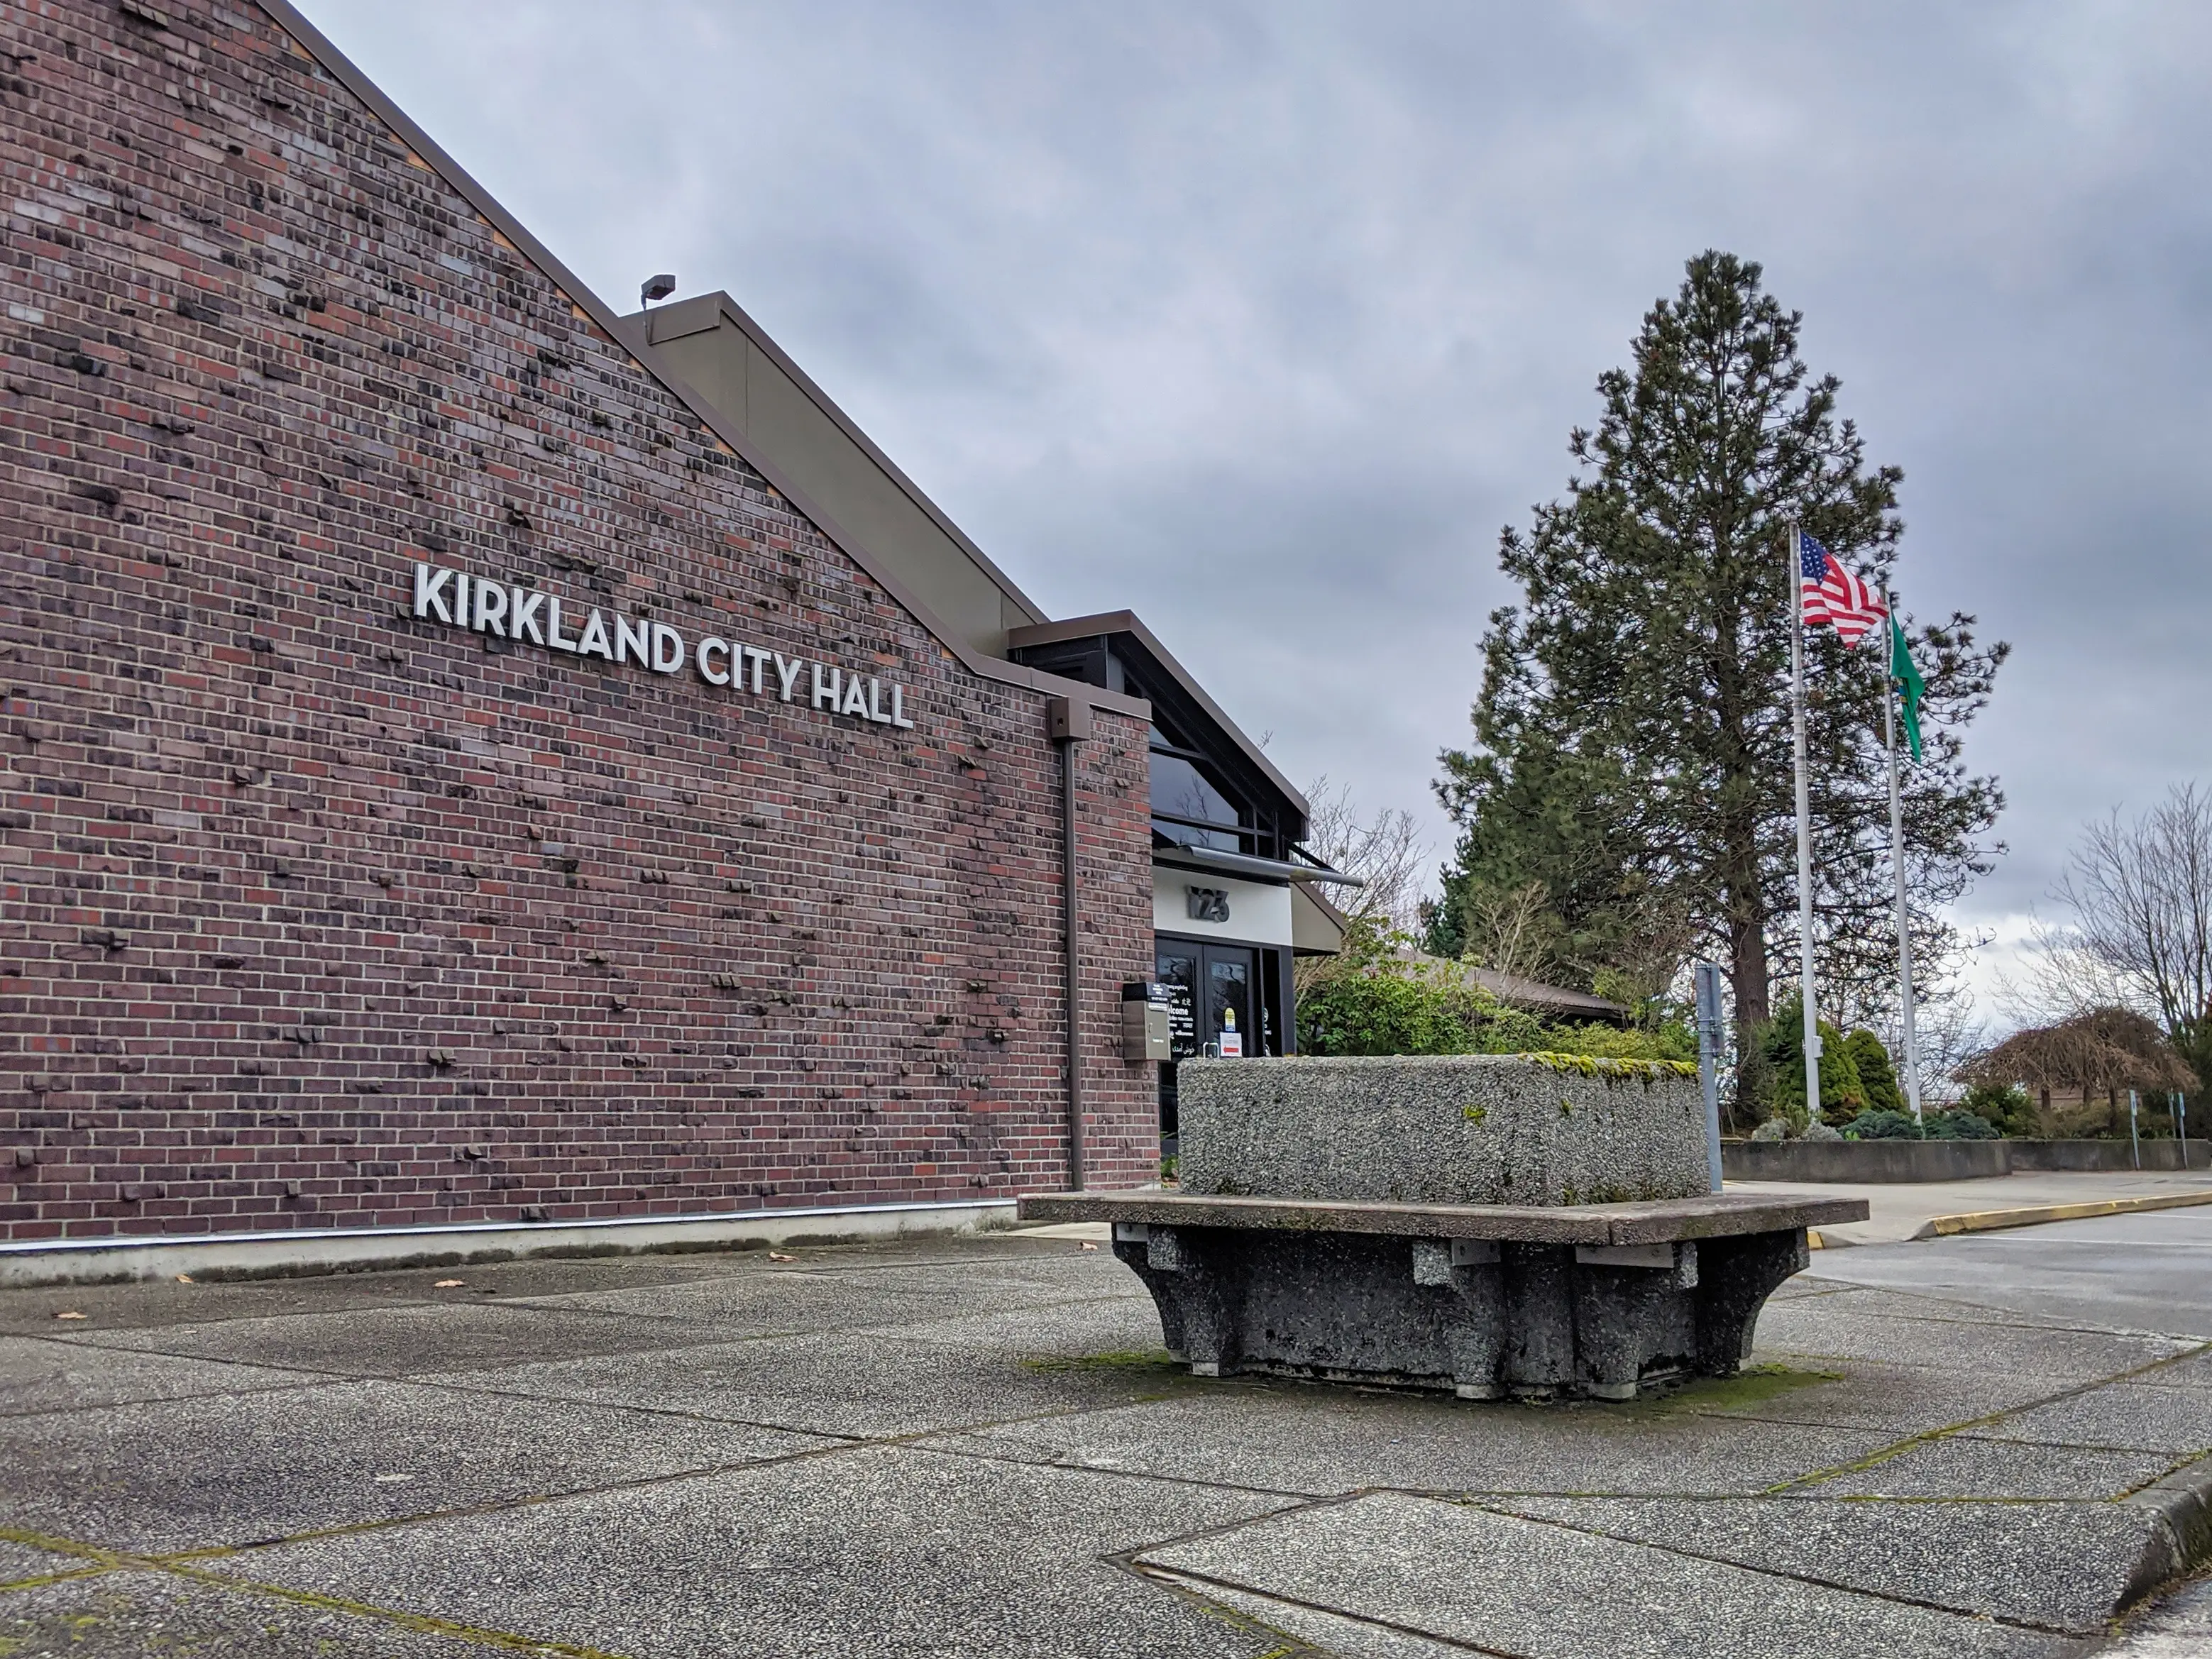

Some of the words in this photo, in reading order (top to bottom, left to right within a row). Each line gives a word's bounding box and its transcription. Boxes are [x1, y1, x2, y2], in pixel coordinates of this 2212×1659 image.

[414, 563, 684, 673] KIRKLAND
[695, 638, 802, 702] CITY
[811, 663, 914, 729] HALL
[1189, 886, 1230, 922] 123
[1168, 1004, 1189, 1015] elcome
